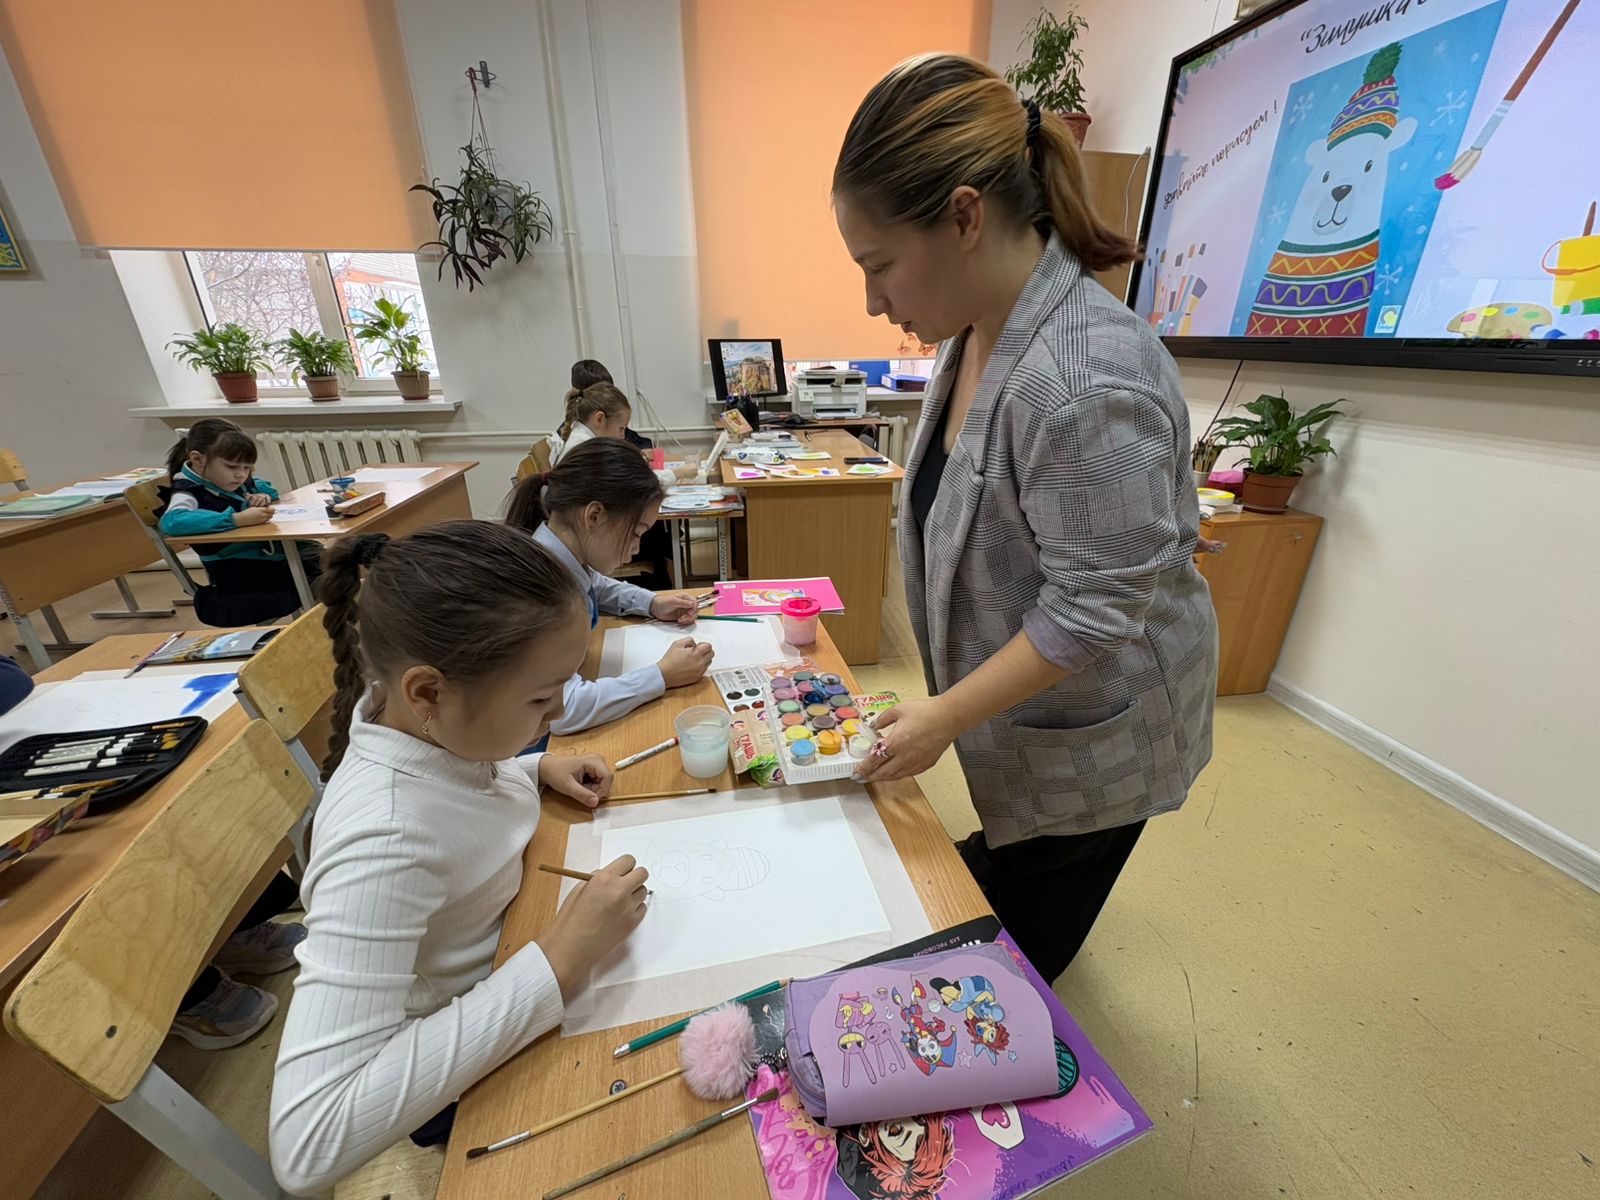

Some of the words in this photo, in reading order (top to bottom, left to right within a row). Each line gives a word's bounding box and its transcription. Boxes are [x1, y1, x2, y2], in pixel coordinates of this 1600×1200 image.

[1211, 110, 1268, 166] порисуем
[854, 694, 894, 704] ГУАШЬ
[739, 733, 756, 761] ГУАШЬ
